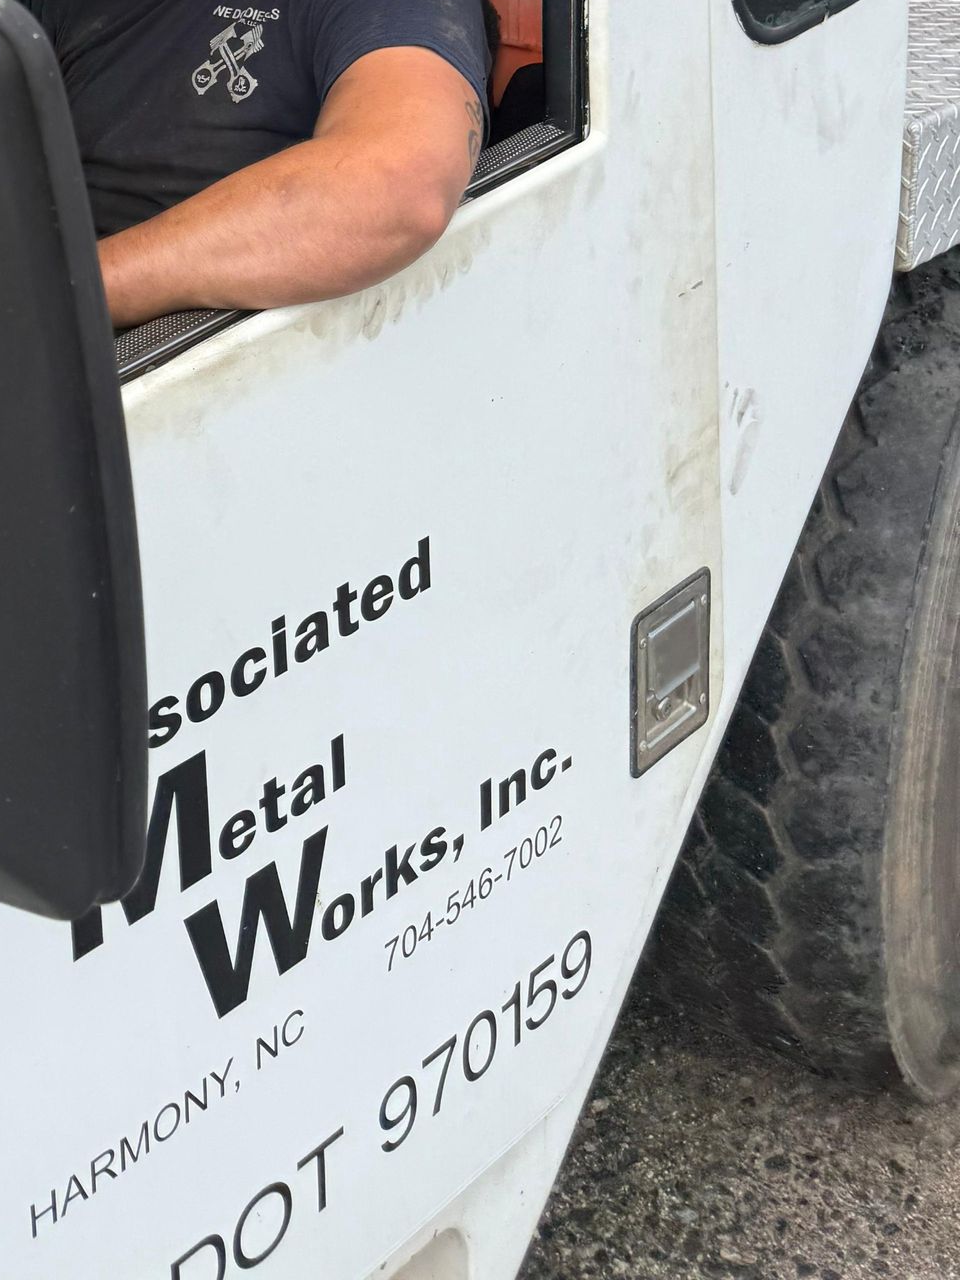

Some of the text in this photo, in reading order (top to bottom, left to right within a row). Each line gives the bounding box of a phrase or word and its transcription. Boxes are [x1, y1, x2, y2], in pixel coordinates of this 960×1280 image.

[147, 535, 432, 750] sociated
[183, 744, 574, 1020] Works, Inc.
[384, 814, 564, 973] 704-546-7002
[29, 1008, 305, 1238] HARMONY, NC
[378, 928, 594, 1153] 970159
